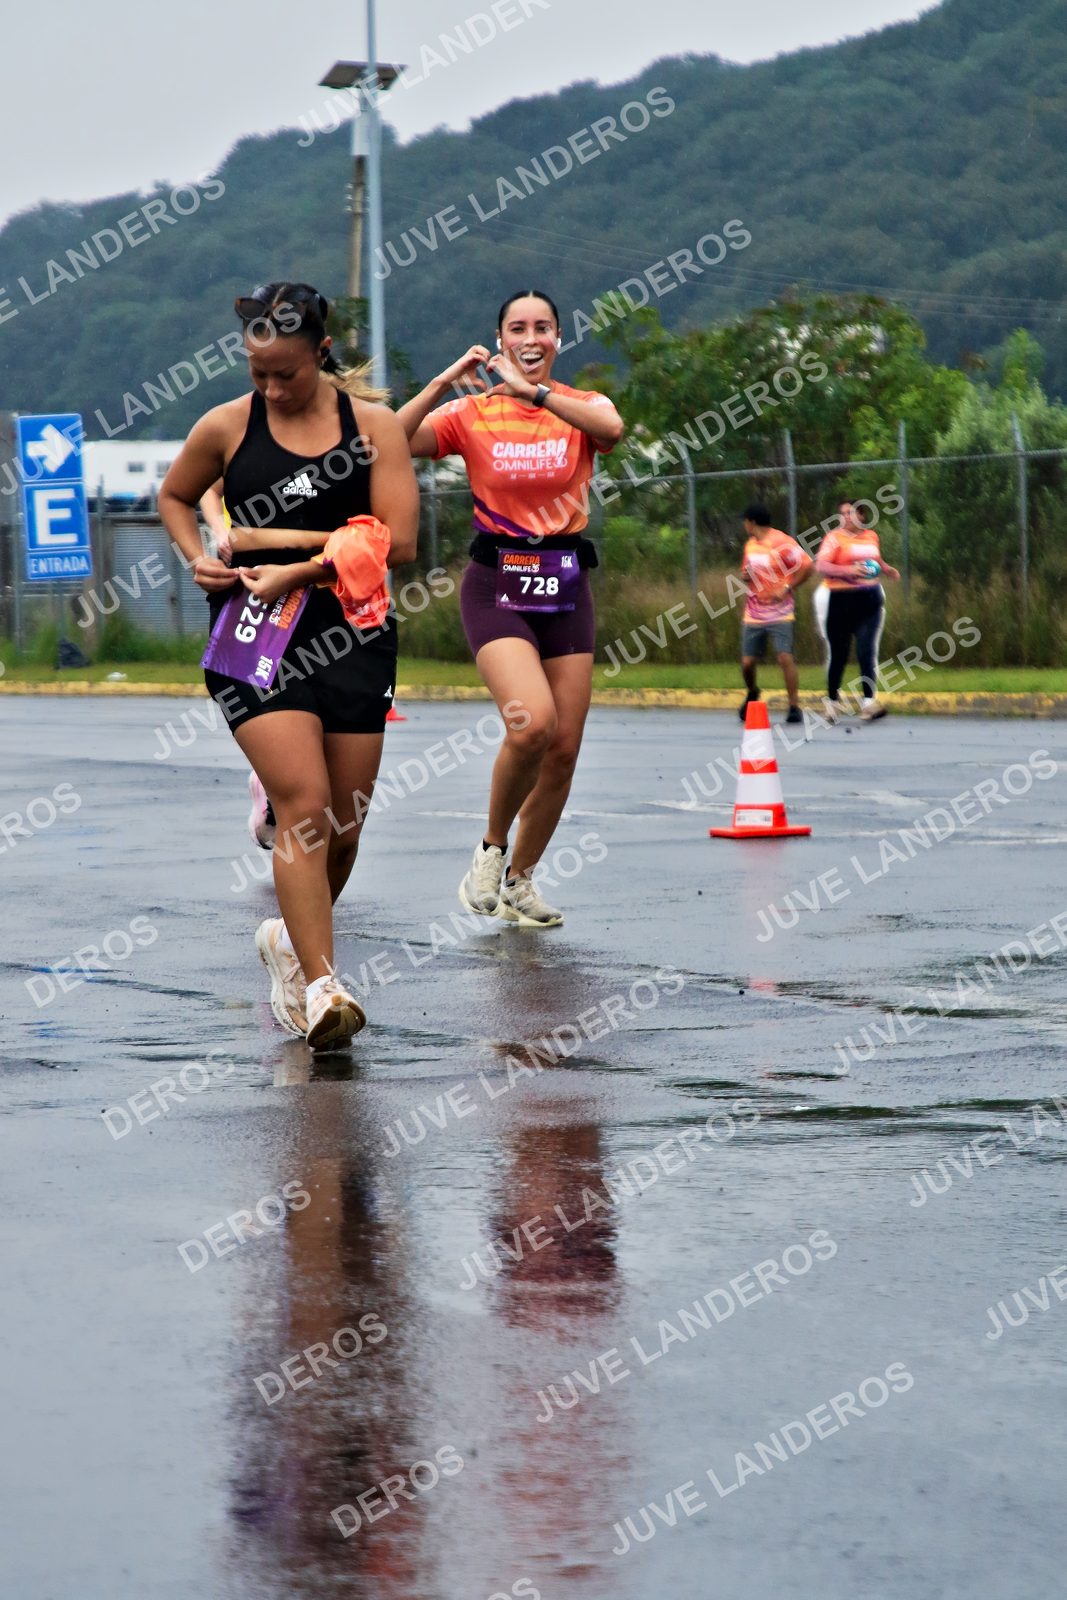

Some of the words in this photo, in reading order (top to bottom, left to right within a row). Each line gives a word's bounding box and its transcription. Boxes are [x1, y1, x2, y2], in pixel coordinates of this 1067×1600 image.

[492, 437, 567, 459] CARRERA
[493, 457, 553, 471] OMNILIFE
[283, 486, 318, 497] adidas
[34, 488, 78, 545] E
[31, 556, 89, 574] ENTRADA
[503, 554, 540, 565] CARRERA
[520, 576, 559, 595] 728
[254, 655, 273, 681] 15K
